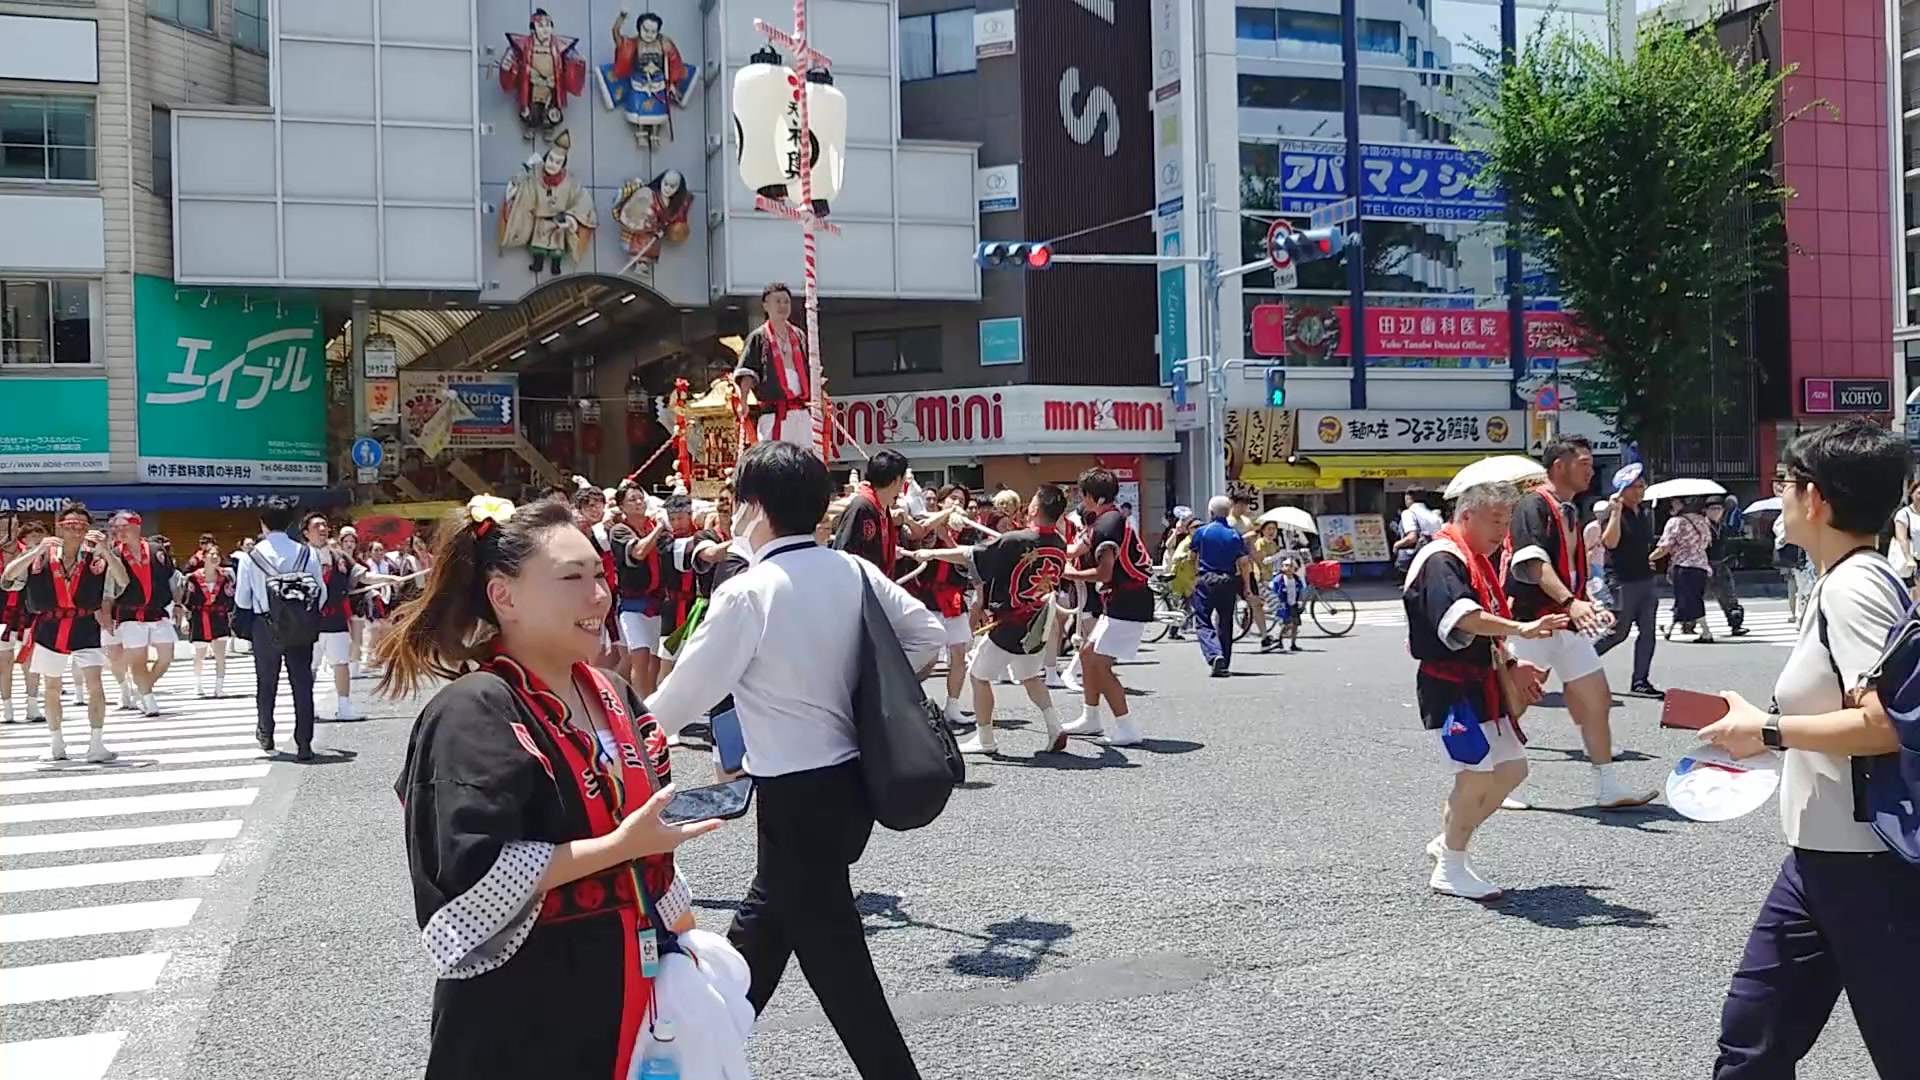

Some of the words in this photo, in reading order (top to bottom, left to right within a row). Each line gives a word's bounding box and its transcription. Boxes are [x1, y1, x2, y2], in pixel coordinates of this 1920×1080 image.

[1378, 317, 1497, 336] 田辺歯科医院
[1435, 340, 1460, 349] Dental
[1462, 340, 1486, 350] Office
[145, 328, 314, 409] エイブル
[1841, 391, 1882, 405] KOHYO
[837, 399, 885, 446] ini
[914, 393, 1003, 441] mini
[1045, 401, 1097, 431] mini
[1112, 401, 1163, 431] mini
[0, 459, 103, 469] p://www.able-mm.com
[148, 463, 252, 480] 仲介手数料家賃の半月分
[0, 497, 11, 511] A
[17, 496, 72, 512] SPORTS
[219, 495, 254, 509] ツチヤ
